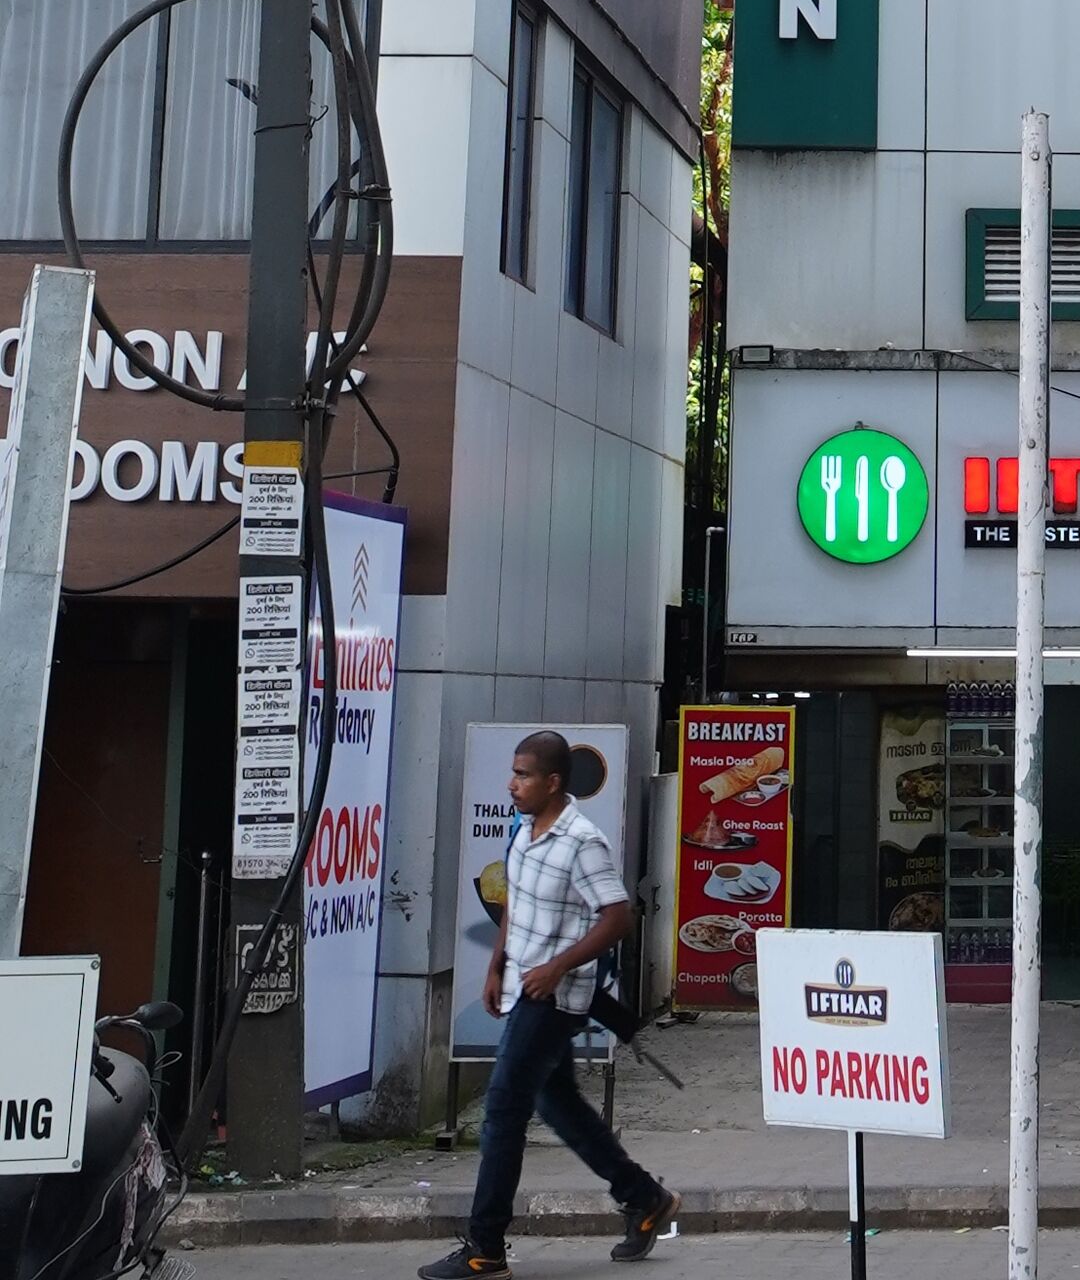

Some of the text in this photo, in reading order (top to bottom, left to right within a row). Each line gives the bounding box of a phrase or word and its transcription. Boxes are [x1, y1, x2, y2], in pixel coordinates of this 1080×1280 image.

[973, 527, 1010, 541] THE
[1045, 527, 1080, 541] STE
[245, 703, 261, 711] 200
[688, 722, 786, 741] BREAKFAST
[690, 756, 754, 766] Masla Dosa
[243, 791, 259, 799] 200
[473, 804, 515, 818] THALA
[473, 824, 503, 838] DUM
[722, 819, 784, 830] Ghee Roast
[694, 860, 713, 871] Idli
[320, 899, 328, 937] &
[330, 894, 355, 935] NON
[356, 885, 375, 933] A/C
[739, 912, 782, 922] Porotta
[811, 992, 882, 1016] IFTHAR
[772, 1046, 930, 1105] NO PARKING
